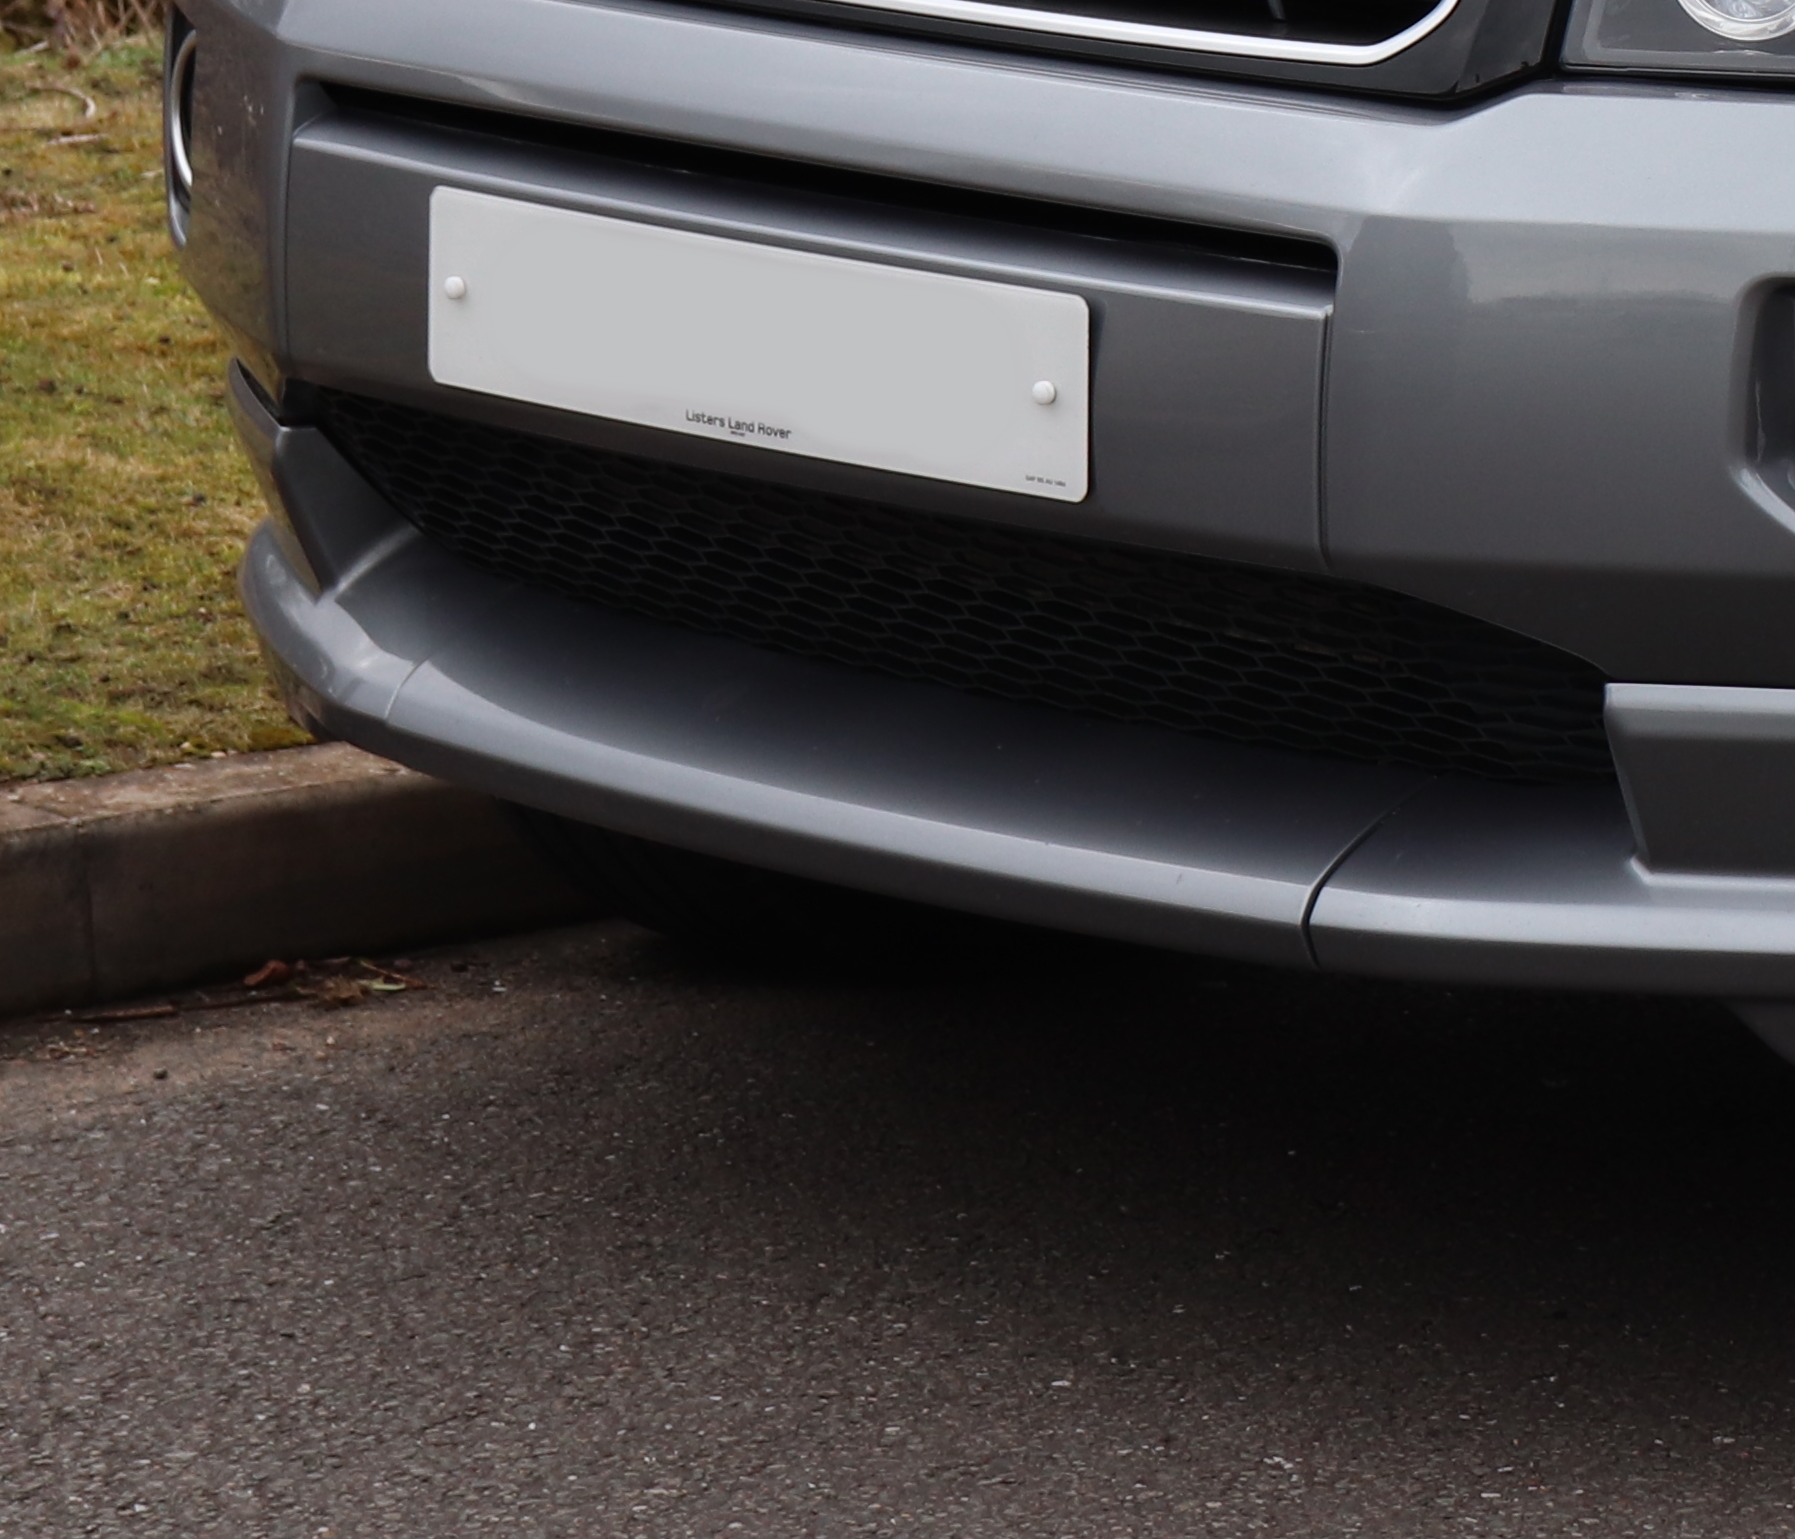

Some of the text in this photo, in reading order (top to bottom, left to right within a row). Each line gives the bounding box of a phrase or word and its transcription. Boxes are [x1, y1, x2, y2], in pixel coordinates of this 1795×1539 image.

[686, 410, 725, 428] Listers
[728, 417, 754, 434] Land
[758, 423, 792, 440] Rover
